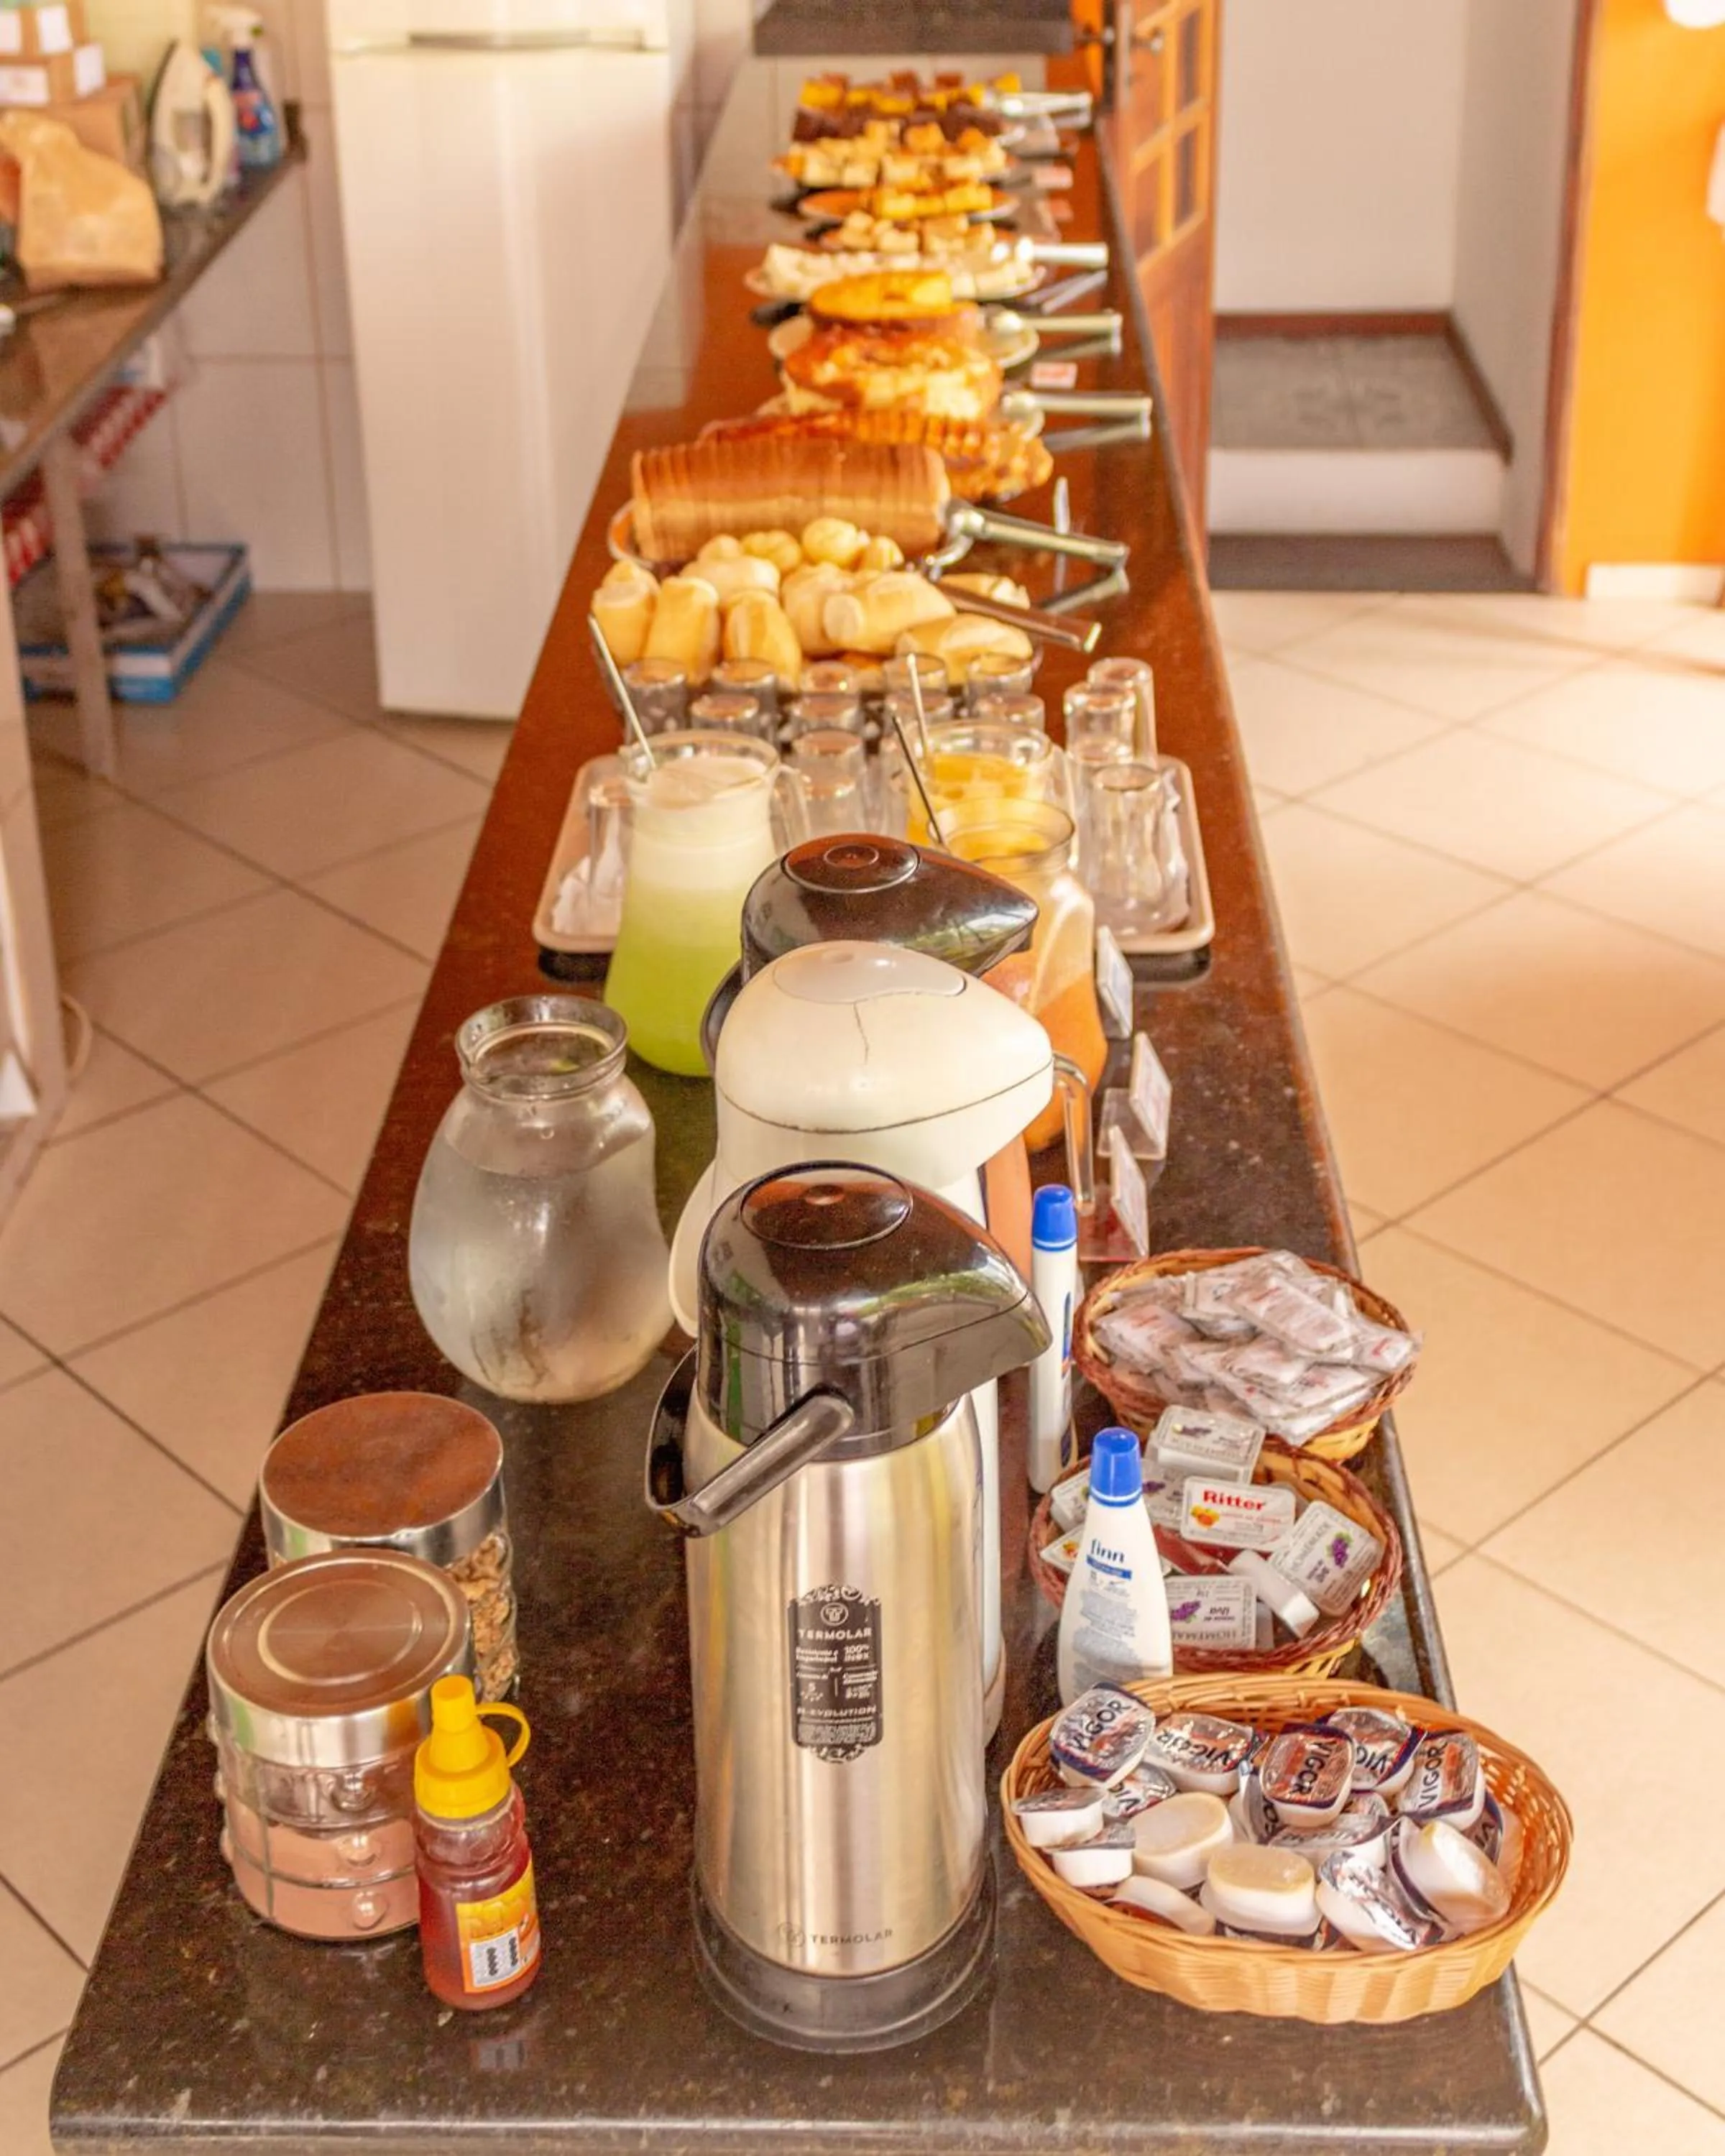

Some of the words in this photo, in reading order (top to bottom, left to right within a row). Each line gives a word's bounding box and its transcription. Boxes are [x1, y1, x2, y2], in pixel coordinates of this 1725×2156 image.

[1203, 1490, 1266, 1511] Ritter
[798, 1627, 873, 1641] TERMOLAR
[1067, 1700, 1133, 1751] VIGOR
[1356, 1746, 1388, 1774] VIG
[1418, 1741, 1448, 1809] VIGOR
[811, 1929, 893, 1945] TERMOLAR
